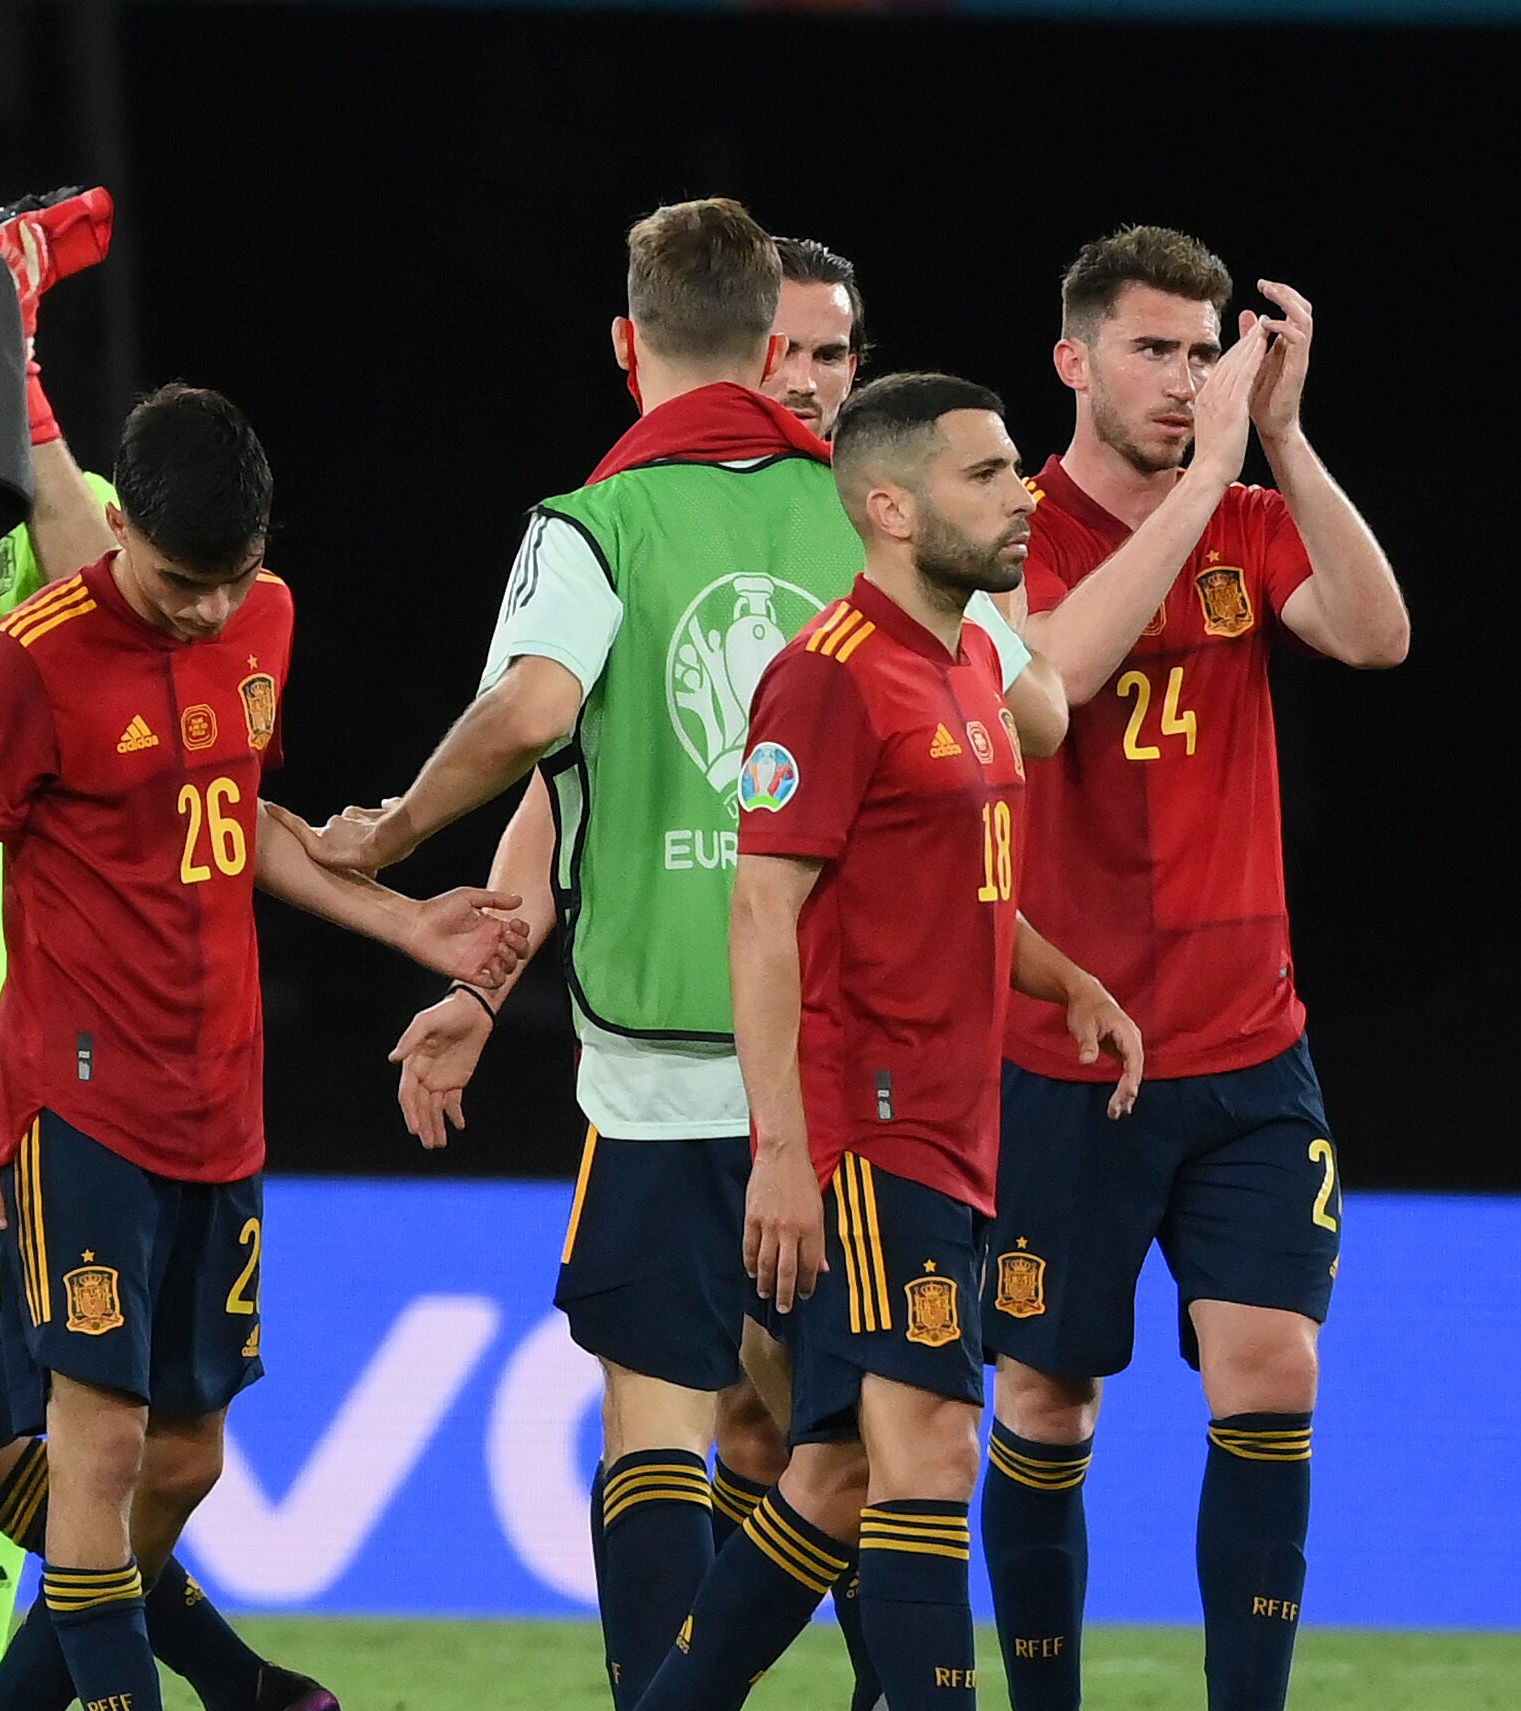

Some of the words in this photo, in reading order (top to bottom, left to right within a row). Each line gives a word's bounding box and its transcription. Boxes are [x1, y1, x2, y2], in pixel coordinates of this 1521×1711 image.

[1116, 666, 1198, 760] 24
[177, 776, 247, 884] 26
[664, 829, 738, 870] EUR
[977, 801, 1012, 902] 18
[1308, 1138, 1342, 1233] 2
[225, 1217, 261, 1315] 2
[1014, 1636, 1065, 1658] RFEF
[1252, 1596, 1299, 1622] RFEF
